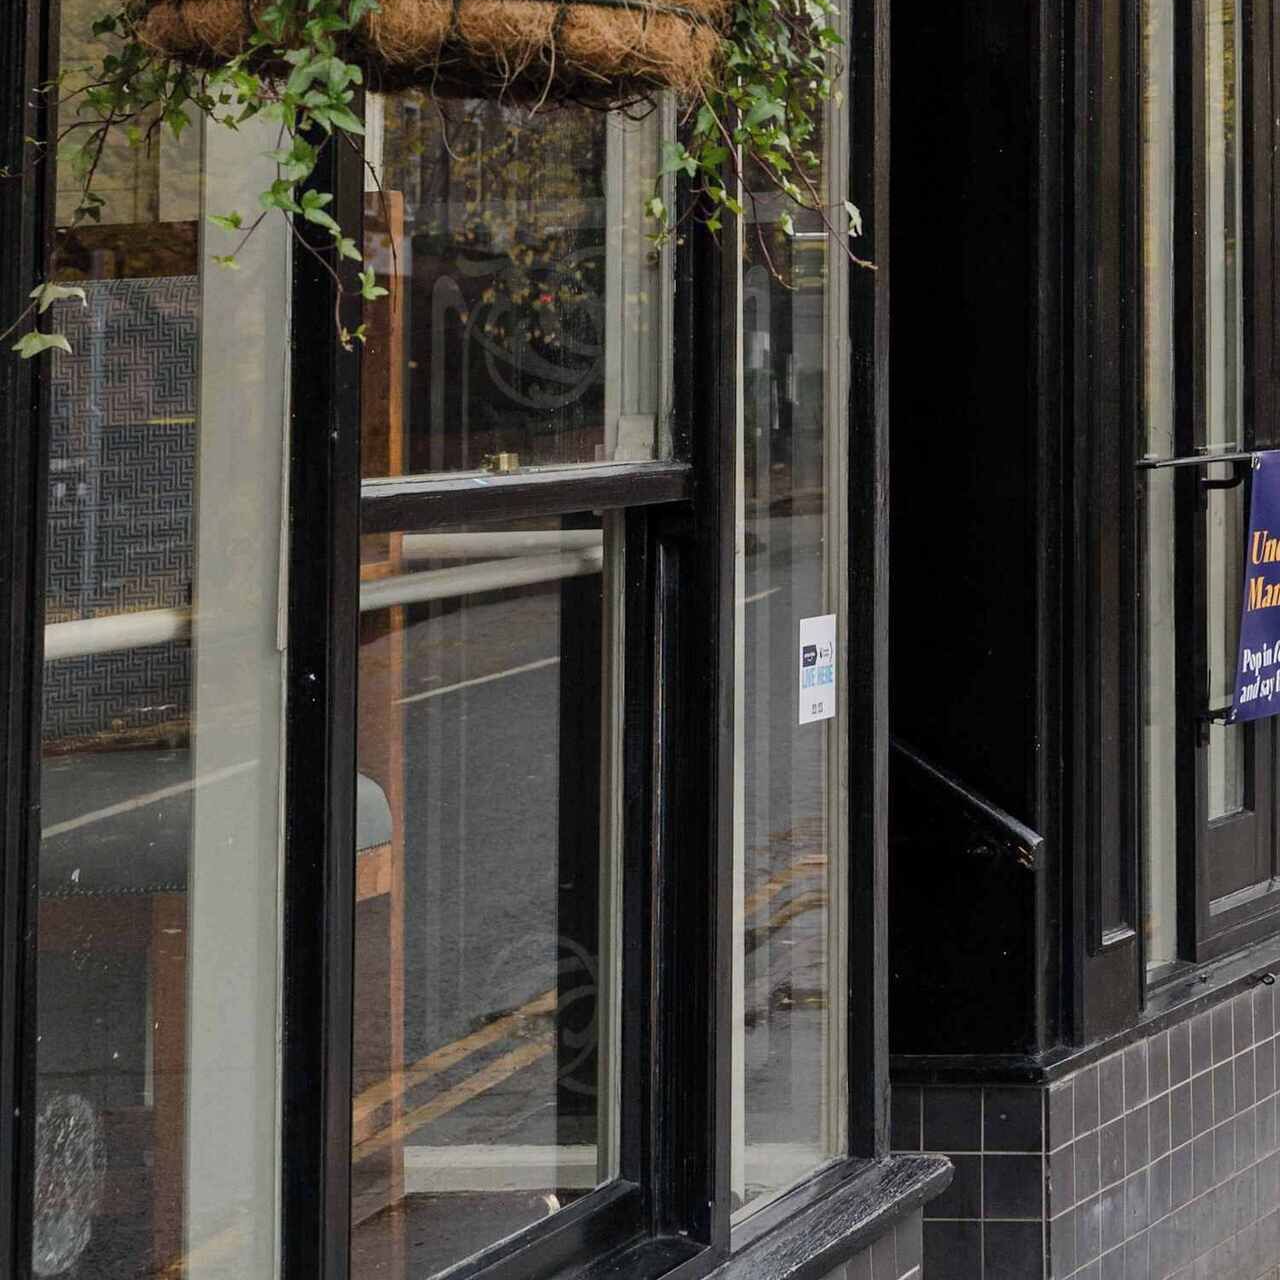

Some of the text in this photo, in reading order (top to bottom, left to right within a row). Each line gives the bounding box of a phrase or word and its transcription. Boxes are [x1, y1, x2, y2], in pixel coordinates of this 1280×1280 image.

[1243, 649, 1262, 676] Pop
[1263, 643, 1272, 667] in
[1240, 676, 1260, 704] and
[1260, 677, 1275, 701] say
